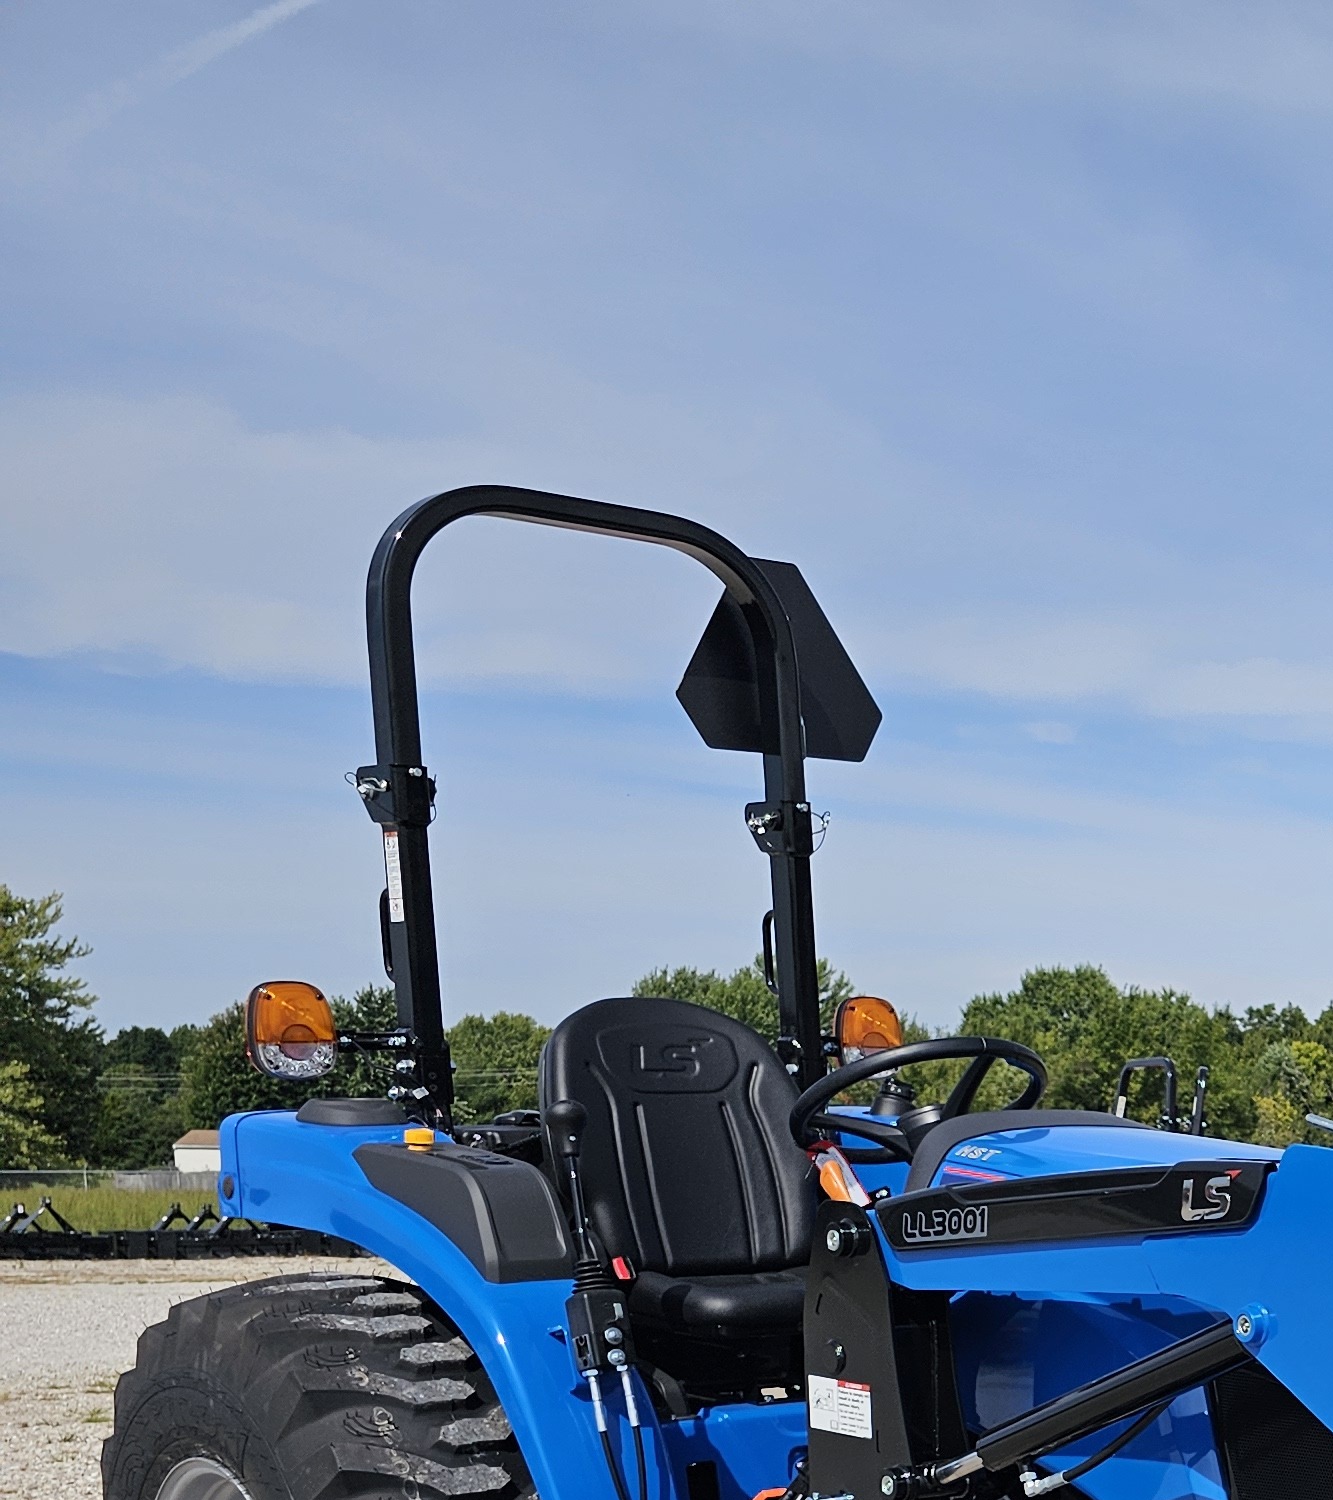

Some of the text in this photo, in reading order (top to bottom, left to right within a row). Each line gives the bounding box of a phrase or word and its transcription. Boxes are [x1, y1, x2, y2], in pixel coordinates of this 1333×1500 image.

[955, 1145, 1002, 1161] HST
[1181, 1175, 1231, 1221] LS
[903, 1205, 988, 1243] LL3001
